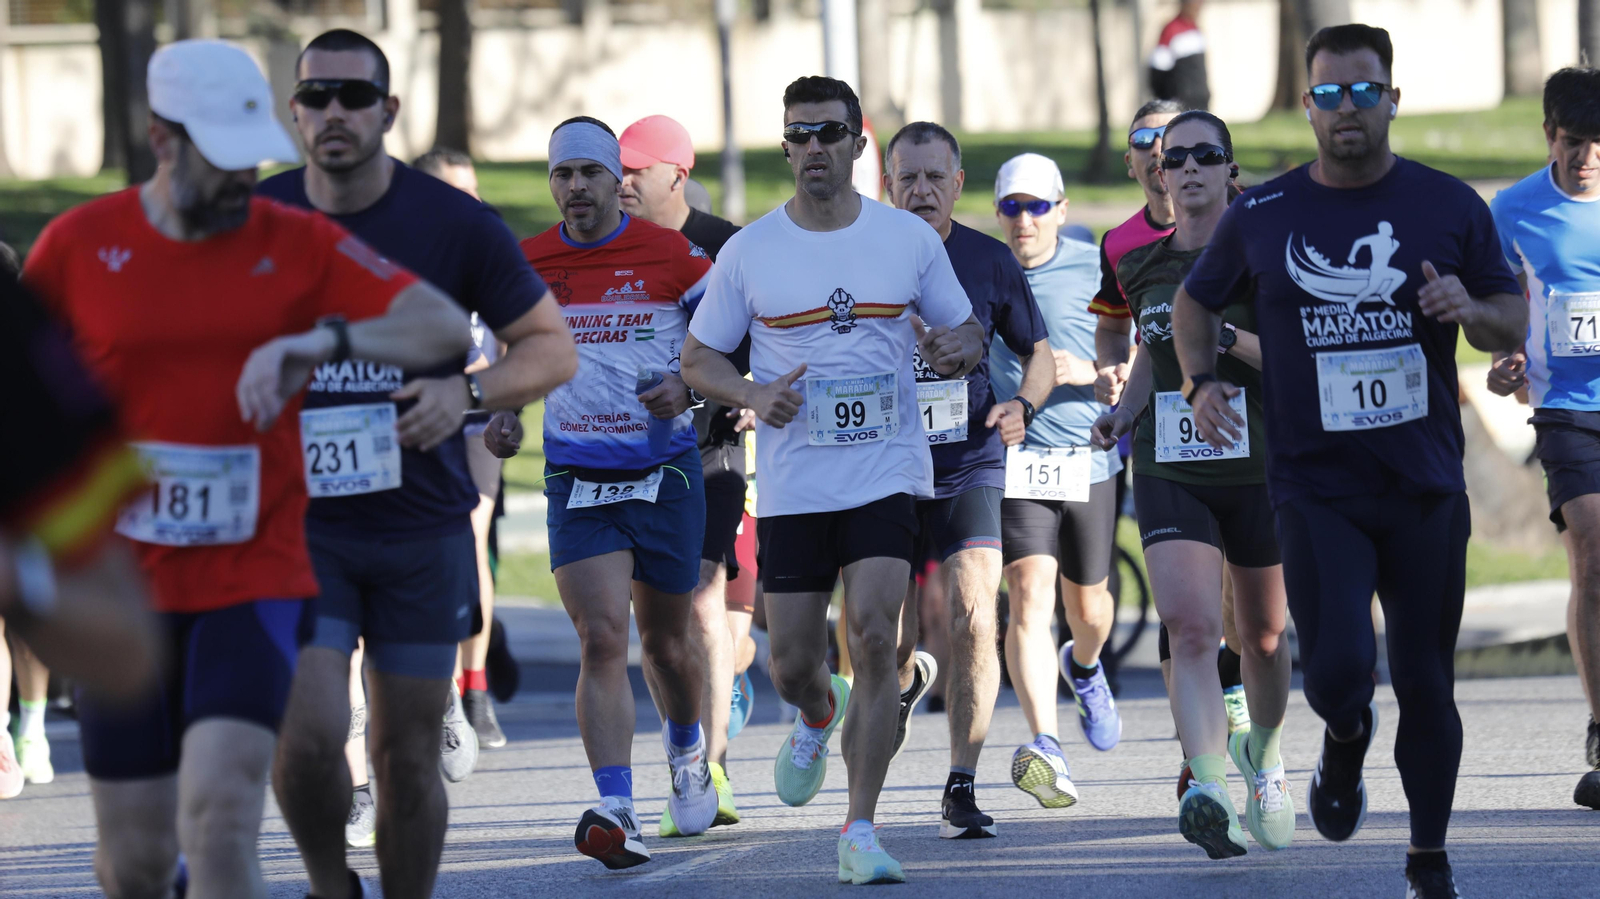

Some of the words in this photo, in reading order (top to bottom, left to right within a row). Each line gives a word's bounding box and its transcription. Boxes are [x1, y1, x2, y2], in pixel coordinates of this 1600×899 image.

[1313, 304, 1349, 316] MEDIA
[616, 313, 654, 327] TEAM
[1302, 307, 1412, 337] MARATÓN
[574, 330, 628, 344] GECIRAS
[1306, 336, 1343, 348] CIUDAD
[1345, 333, 1360, 344] DE
[1362, 328, 1413, 342] ALGECIRAS
[1570, 345, 1600, 354] EVO
[835, 383, 874, 395] MARATÓN
[1352, 379, 1387, 410] 10
[834, 400, 866, 429] 99
[923, 405, 933, 430] 1
[1351, 411, 1404, 426] EVOS
[560, 421, 589, 433] GÓMEZ
[834, 430, 878, 443] EVOS
[926, 433, 948, 443] OS
[307, 439, 358, 475] 231
[1178, 447, 1224, 458] EVOS
[1025, 464, 1061, 485] 151
[319, 479, 371, 494] EVOS
[1028, 489, 1067, 498] EVOS
[152, 480, 210, 521] 181
[1144, 527, 1182, 540] LURBEL
